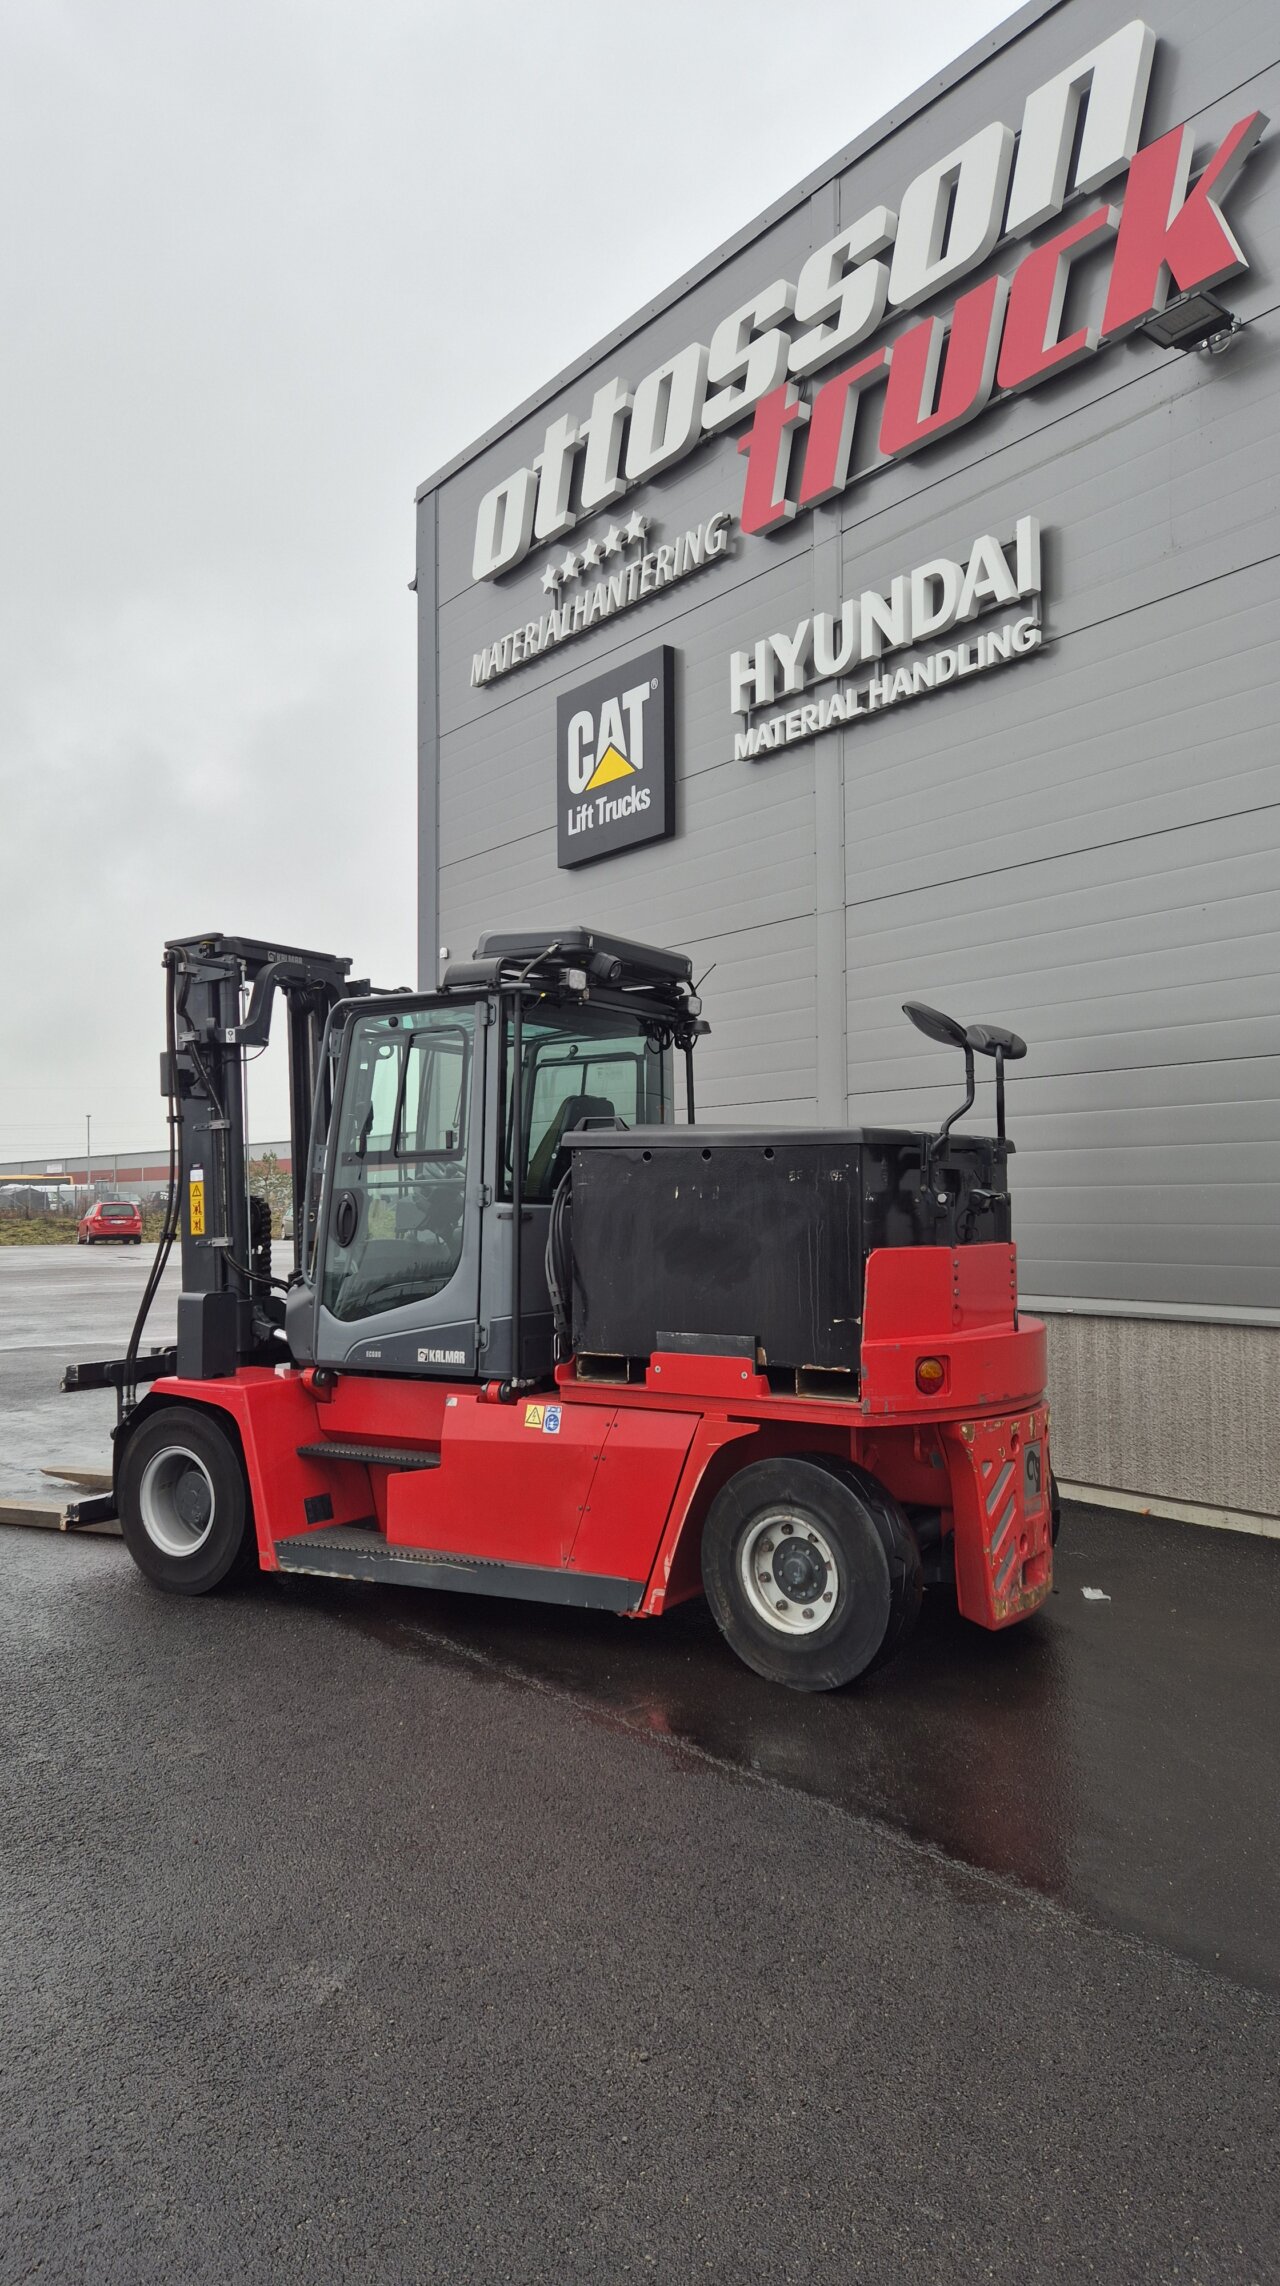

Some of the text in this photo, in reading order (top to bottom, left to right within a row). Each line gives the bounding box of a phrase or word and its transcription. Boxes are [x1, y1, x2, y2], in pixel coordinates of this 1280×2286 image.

[472, 19, 1155, 582] ottosson
[738, 110, 1271, 538] truck
[470, 511, 728, 687] MATERIALHANTERING
[730, 515, 1042, 715] HYUNDAI
[567, 681, 650, 795] CAT
[734, 616, 1042, 761] MATERIAL HANDLING
[568, 785, 651, 836] Lift Trucks
[429, 1350, 465, 1364] KALMAR
